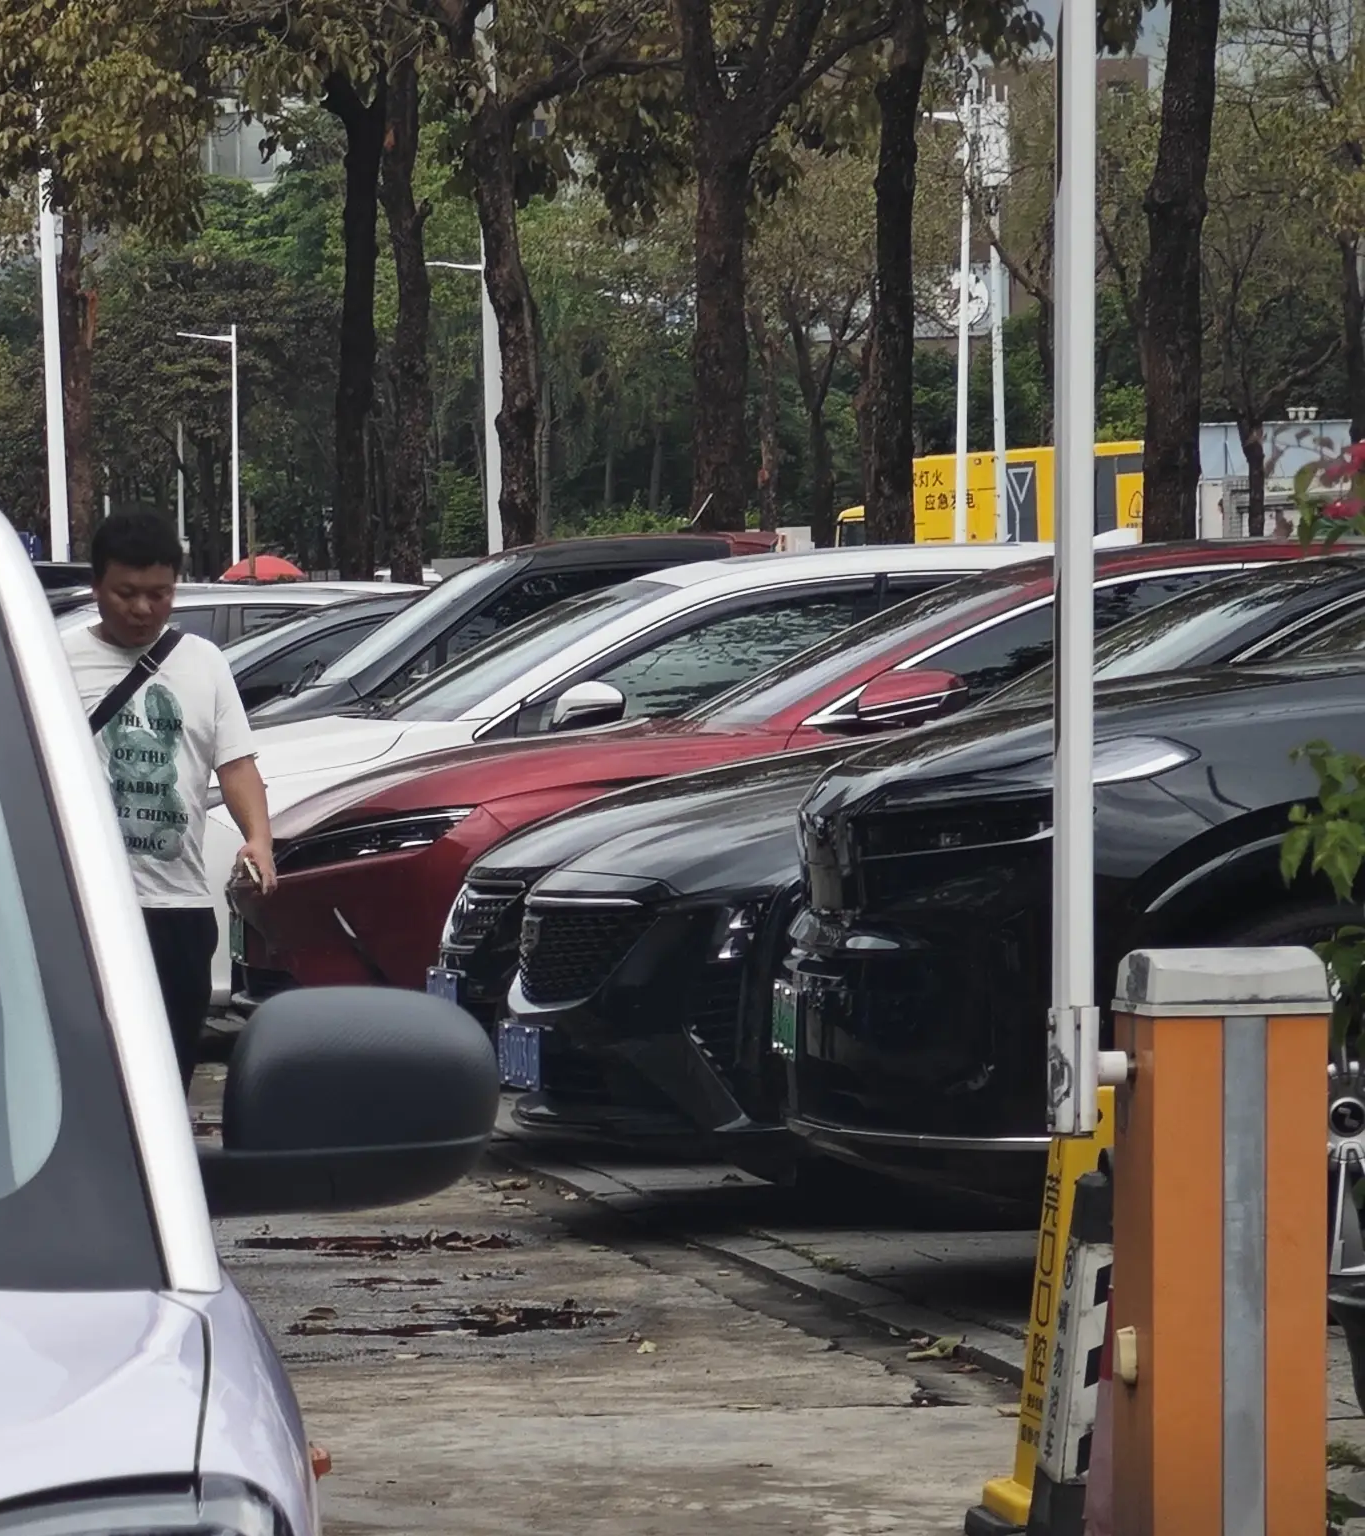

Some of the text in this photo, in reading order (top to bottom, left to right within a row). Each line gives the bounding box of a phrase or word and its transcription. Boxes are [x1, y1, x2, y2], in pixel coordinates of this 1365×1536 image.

[147, 718, 183, 732] YEAR
[114, 747, 169, 764] OF THE
[116, 779, 169, 796] RABBIT
